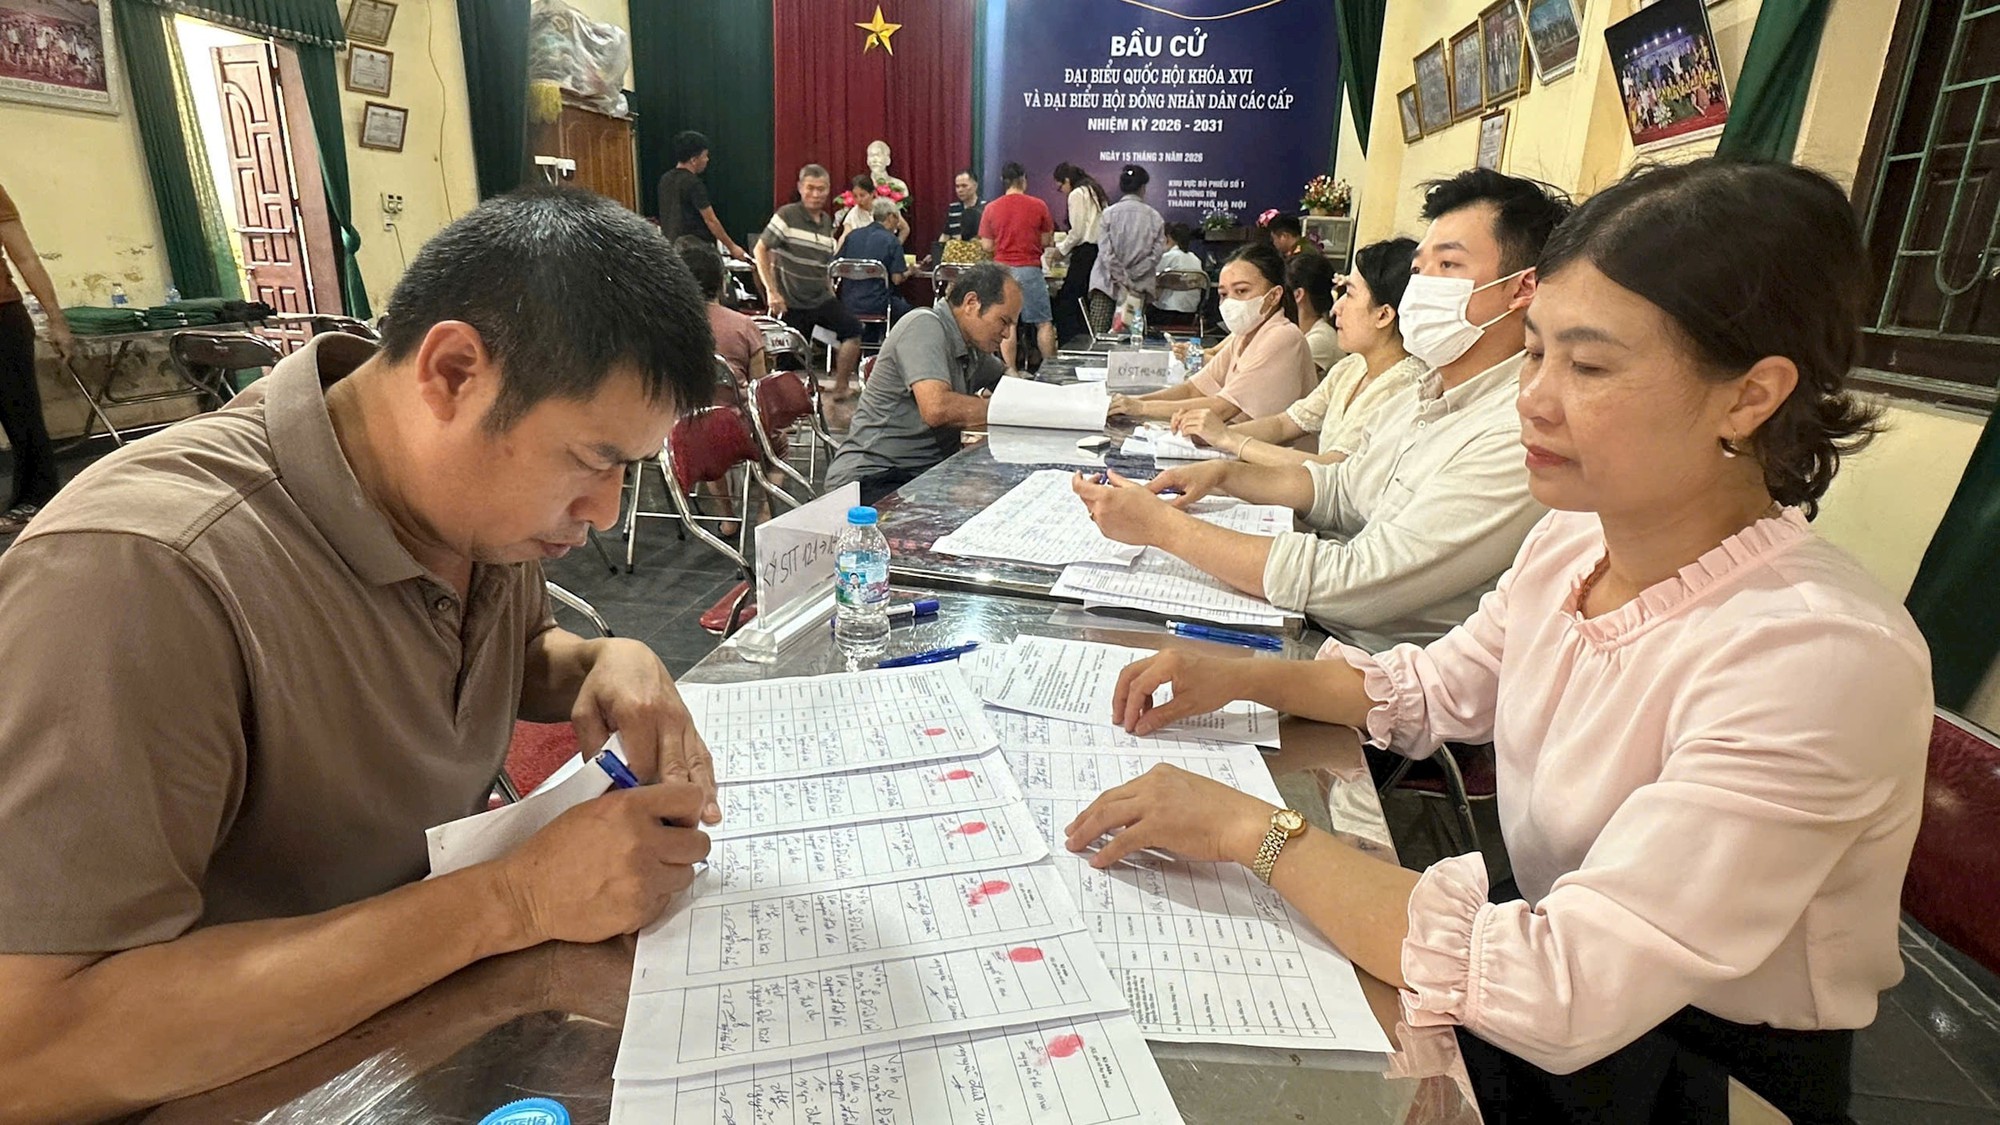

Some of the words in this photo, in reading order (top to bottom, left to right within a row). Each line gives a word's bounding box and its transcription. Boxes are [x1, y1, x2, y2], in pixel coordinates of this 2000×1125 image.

[1111, 27, 1162, 57] BẦU
[1170, 27, 1208, 57] CỬ
[1065, 69, 1087, 87] ĐẠI
[1091, 59, 1120, 84] BIỂU
[1124, 62, 1158, 86] QUỐC
[1161, 65, 1184, 87] HỘI
[1189, 65, 1224, 84] KHÓA
[1228, 69, 1253, 85] XVI
[1024, 89, 1041, 108] VÀ
[1044, 92, 1066, 111] ĐẠI
[1070, 84, 1099, 109] BIỂU
[1102, 90, 1125, 112] HỘI
[1129, 86, 1165, 109] ĐỒNG
[1167, 90, 1205, 109] NHÂN
[1209, 90, 1236, 109] DÂN
[1239, 90, 1265, 110] CÁC
[1268, 87, 1294, 110] CẤP
[1088, 117, 1128, 133] NHIỆM
[1131, 116, 1148, 132] KỲ
[1151, 119, 1181, 132] 2026
[1194, 119, 1223, 132] 2031
[1100, 150, 1119, 161] NGÀY
[1122, 152, 1130, 161] 15
[1133, 150, 1157, 162] THÁNG
[1158, 153, 1163, 161] 3
[1166, 151, 1183, 162] NĂM
[1185, 153, 1203, 163] 2026
[781, 545, 799, 583] STT
